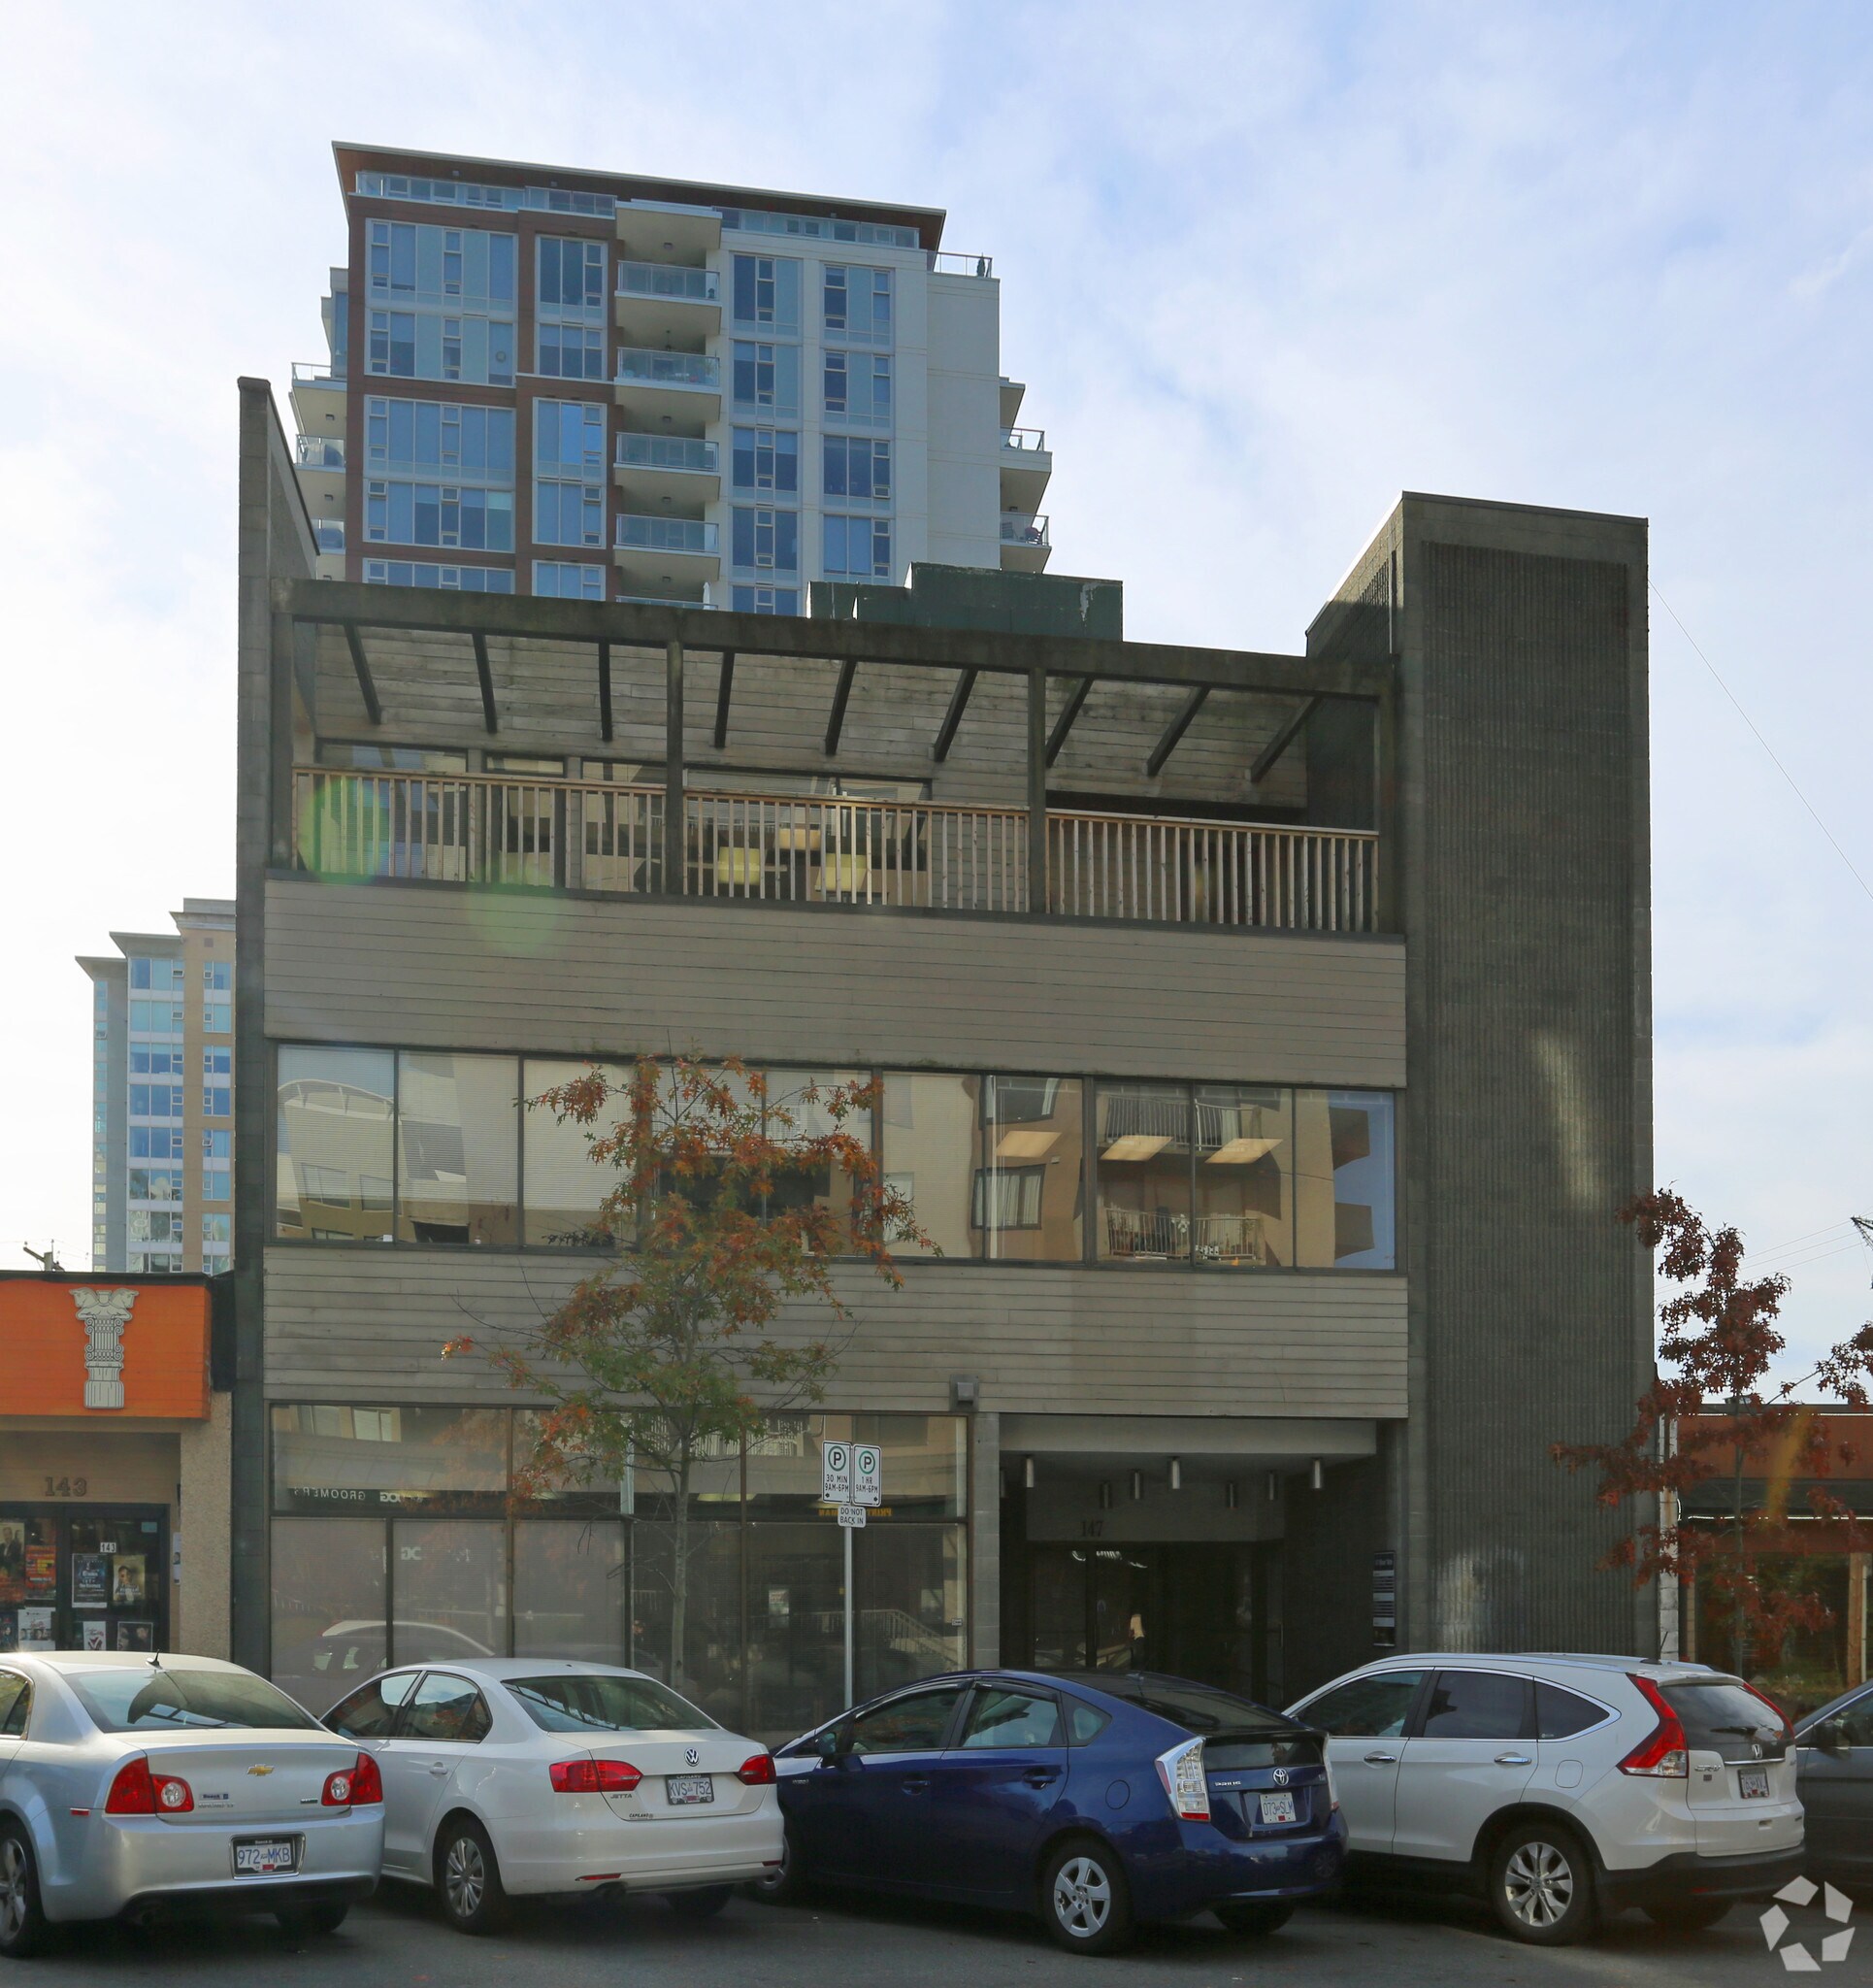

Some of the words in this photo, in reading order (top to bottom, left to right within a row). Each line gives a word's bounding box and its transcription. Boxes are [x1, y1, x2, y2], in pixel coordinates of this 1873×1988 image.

[834, 1452, 841, 1466] P
[864, 1456, 871, 1469] P
[45, 1476, 87, 1497] 143
[825, 1483, 848, 1492] 9AM-6PM
[850, 1508, 863, 1516] NOT
[1080, 1519, 1104, 1538] 147
[102, 1543, 115, 1552] 143
[670, 1781, 688, 1797] KVS
[693, 1781, 711, 1795] 752
[238, 1848, 261, 1866] 972
[267, 1847, 290, 1863] MKB
